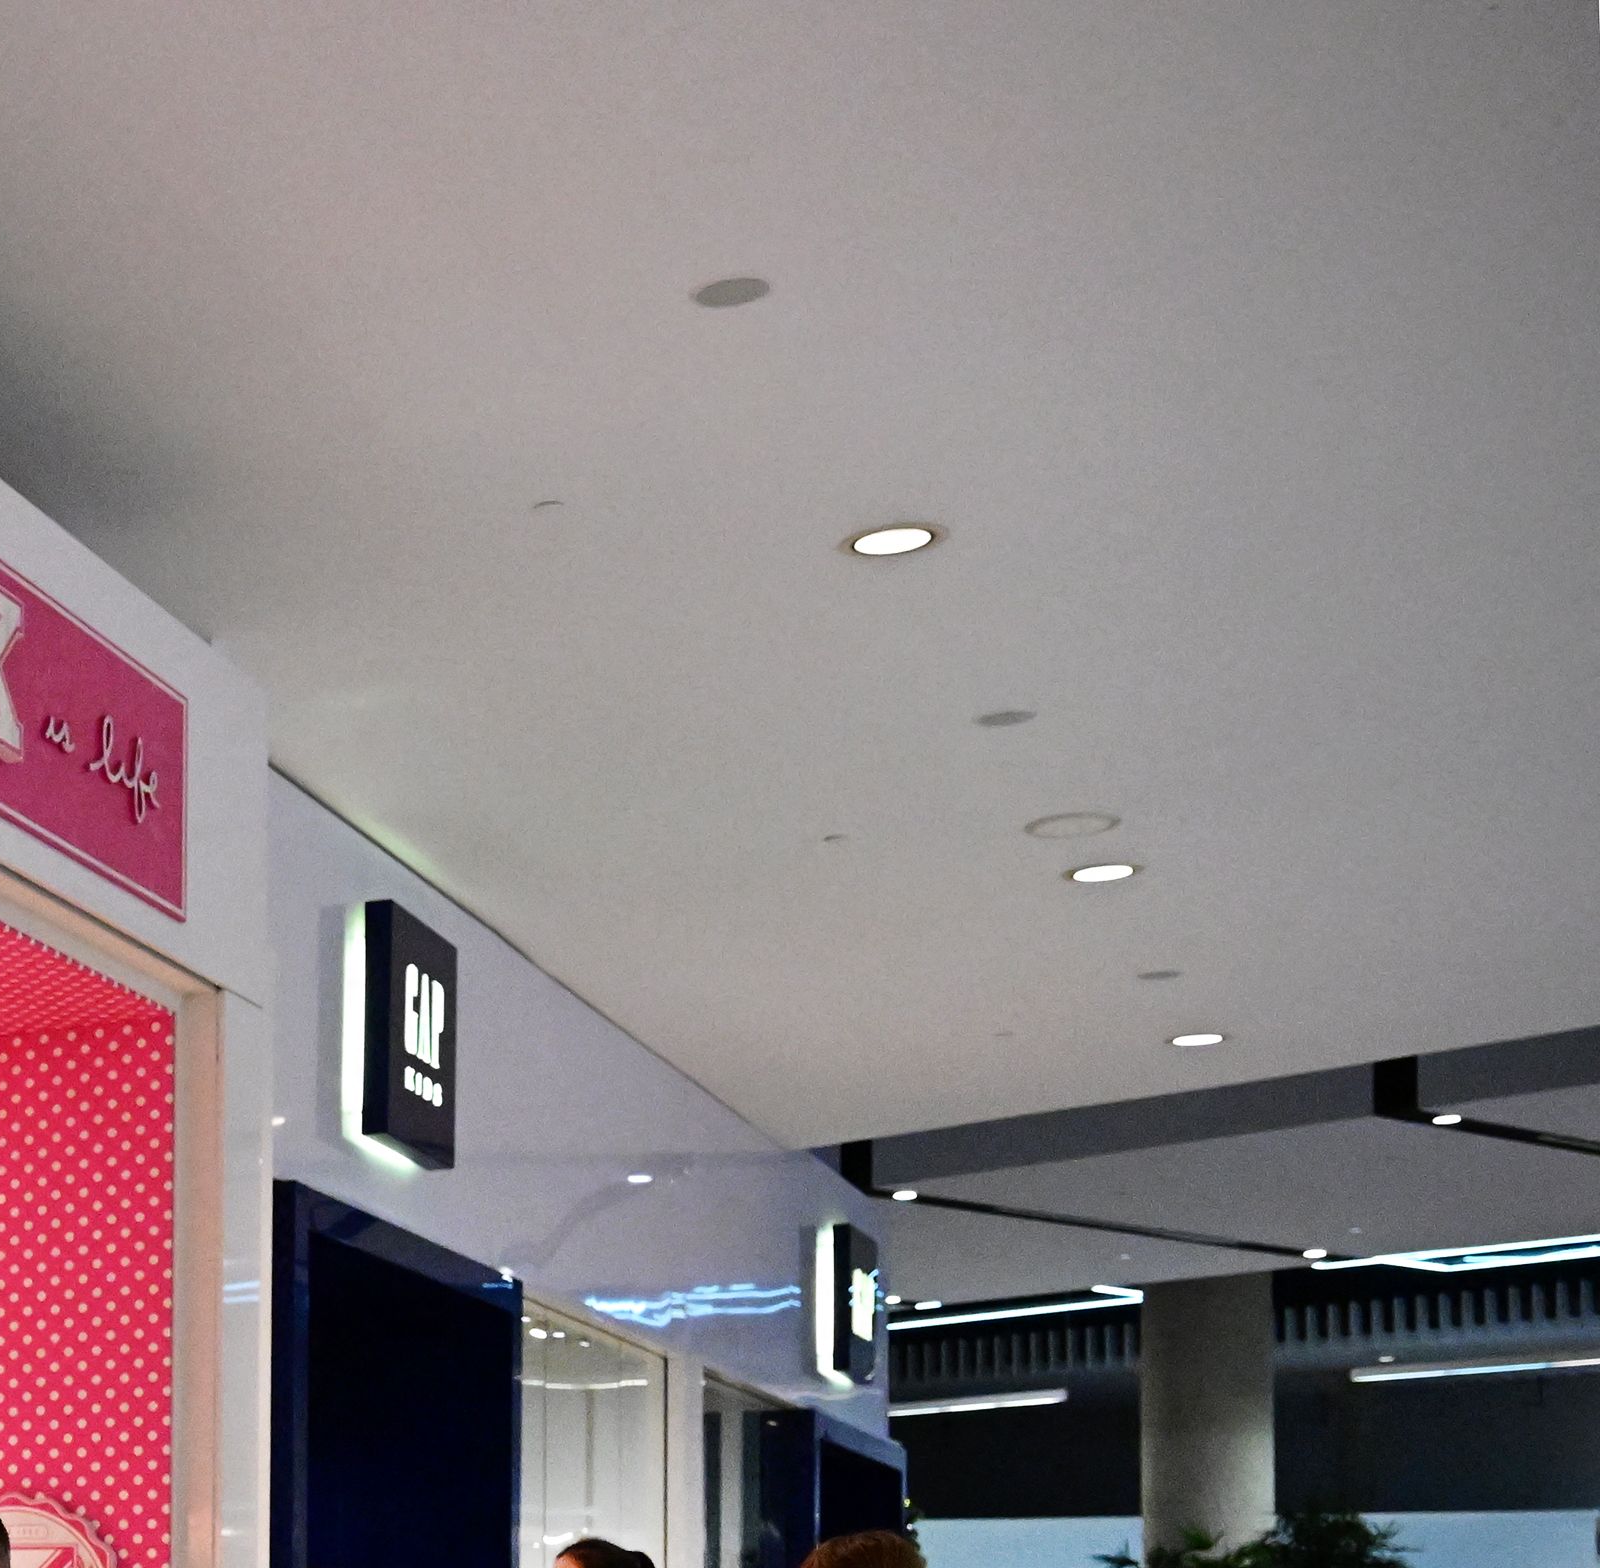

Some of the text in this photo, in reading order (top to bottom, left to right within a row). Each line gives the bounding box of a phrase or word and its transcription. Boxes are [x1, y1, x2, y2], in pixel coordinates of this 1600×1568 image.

[45, 716, 76, 754] is
[89, 714, 162, 824] life
[404, 963, 445, 1070] GAP
